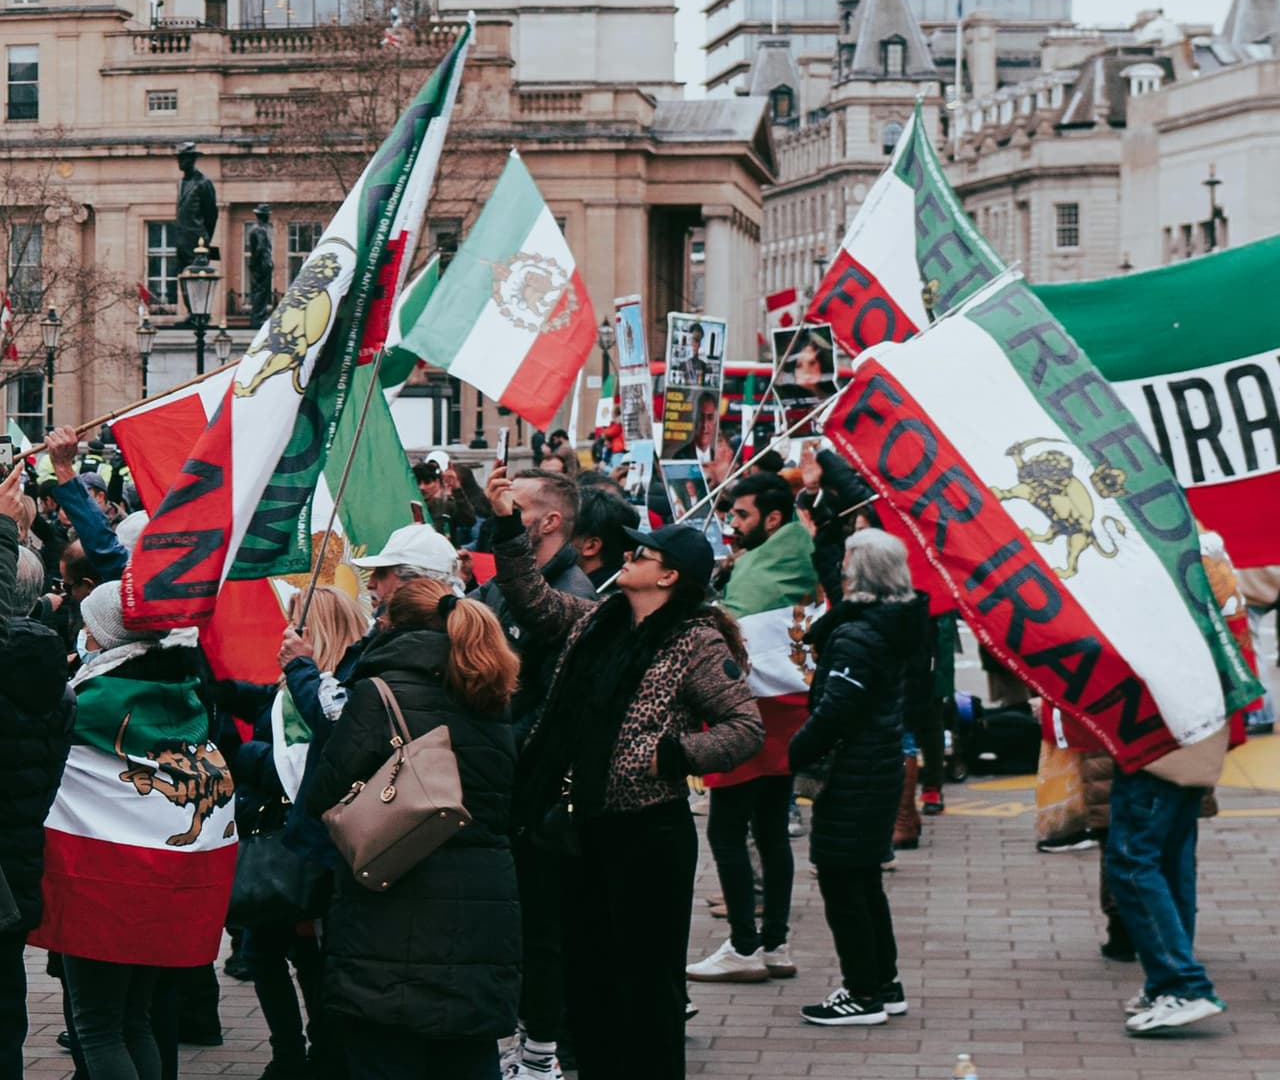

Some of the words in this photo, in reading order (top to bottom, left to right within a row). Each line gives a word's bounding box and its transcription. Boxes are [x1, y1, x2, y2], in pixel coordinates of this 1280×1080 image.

[367, 233, 387, 272] ACCEPT
[1142, 363, 1280, 483] IRA
[843, 373, 984, 551] FOR
[963, 539, 1163, 748] IRAN
